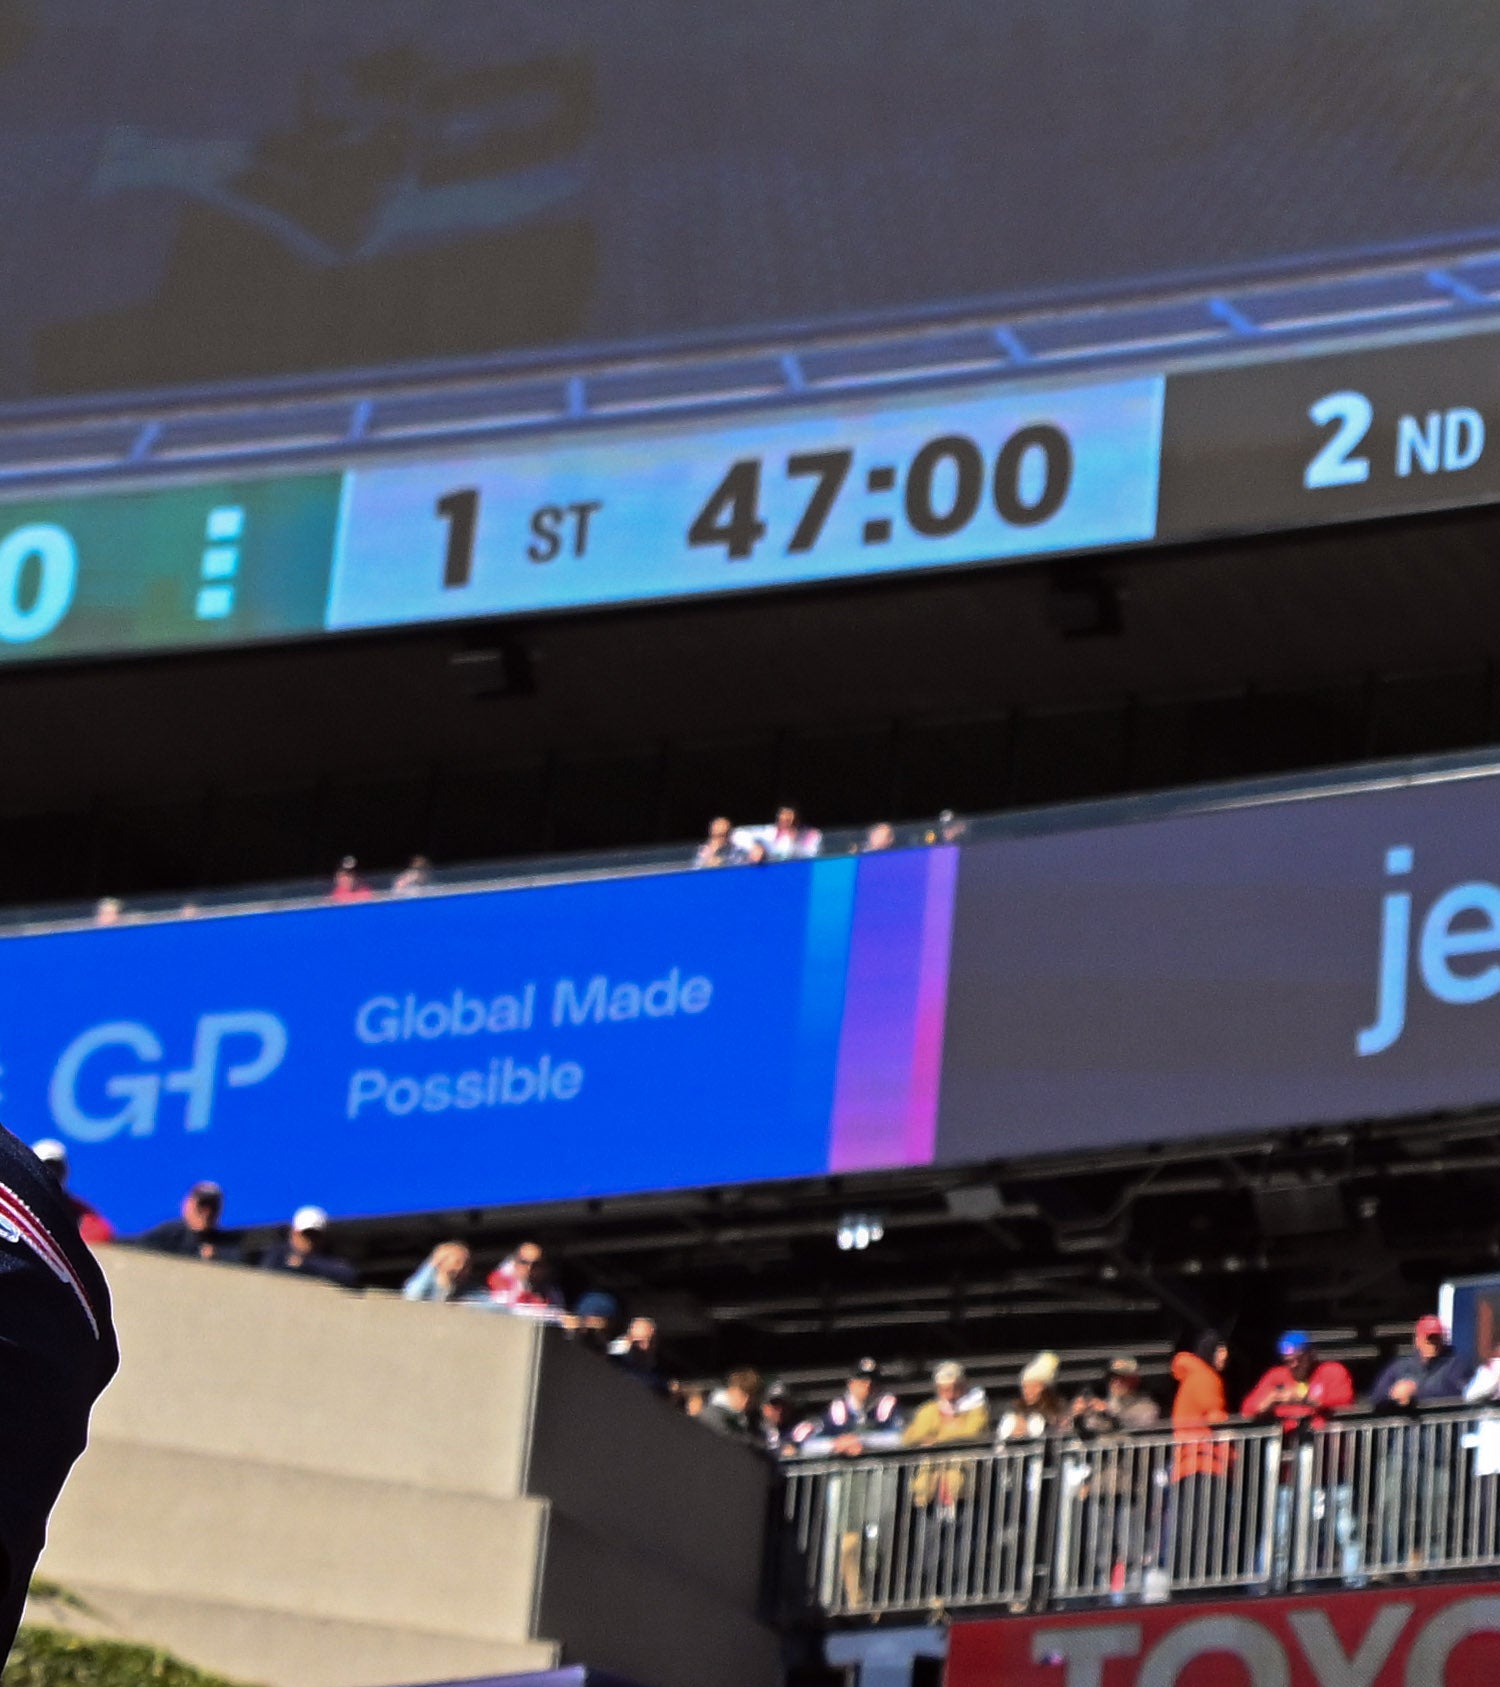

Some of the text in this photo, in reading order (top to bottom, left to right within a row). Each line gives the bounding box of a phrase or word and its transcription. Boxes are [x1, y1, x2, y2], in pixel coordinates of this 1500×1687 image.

[1305, 390, 1373, 490] 2
[1395, 407, 1485, 478] ND
[435, 423, 1073, 590] 1 ST 47:00
[354, 966, 714, 1045] Global Made
[346, 1053, 585, 1119] Possible
